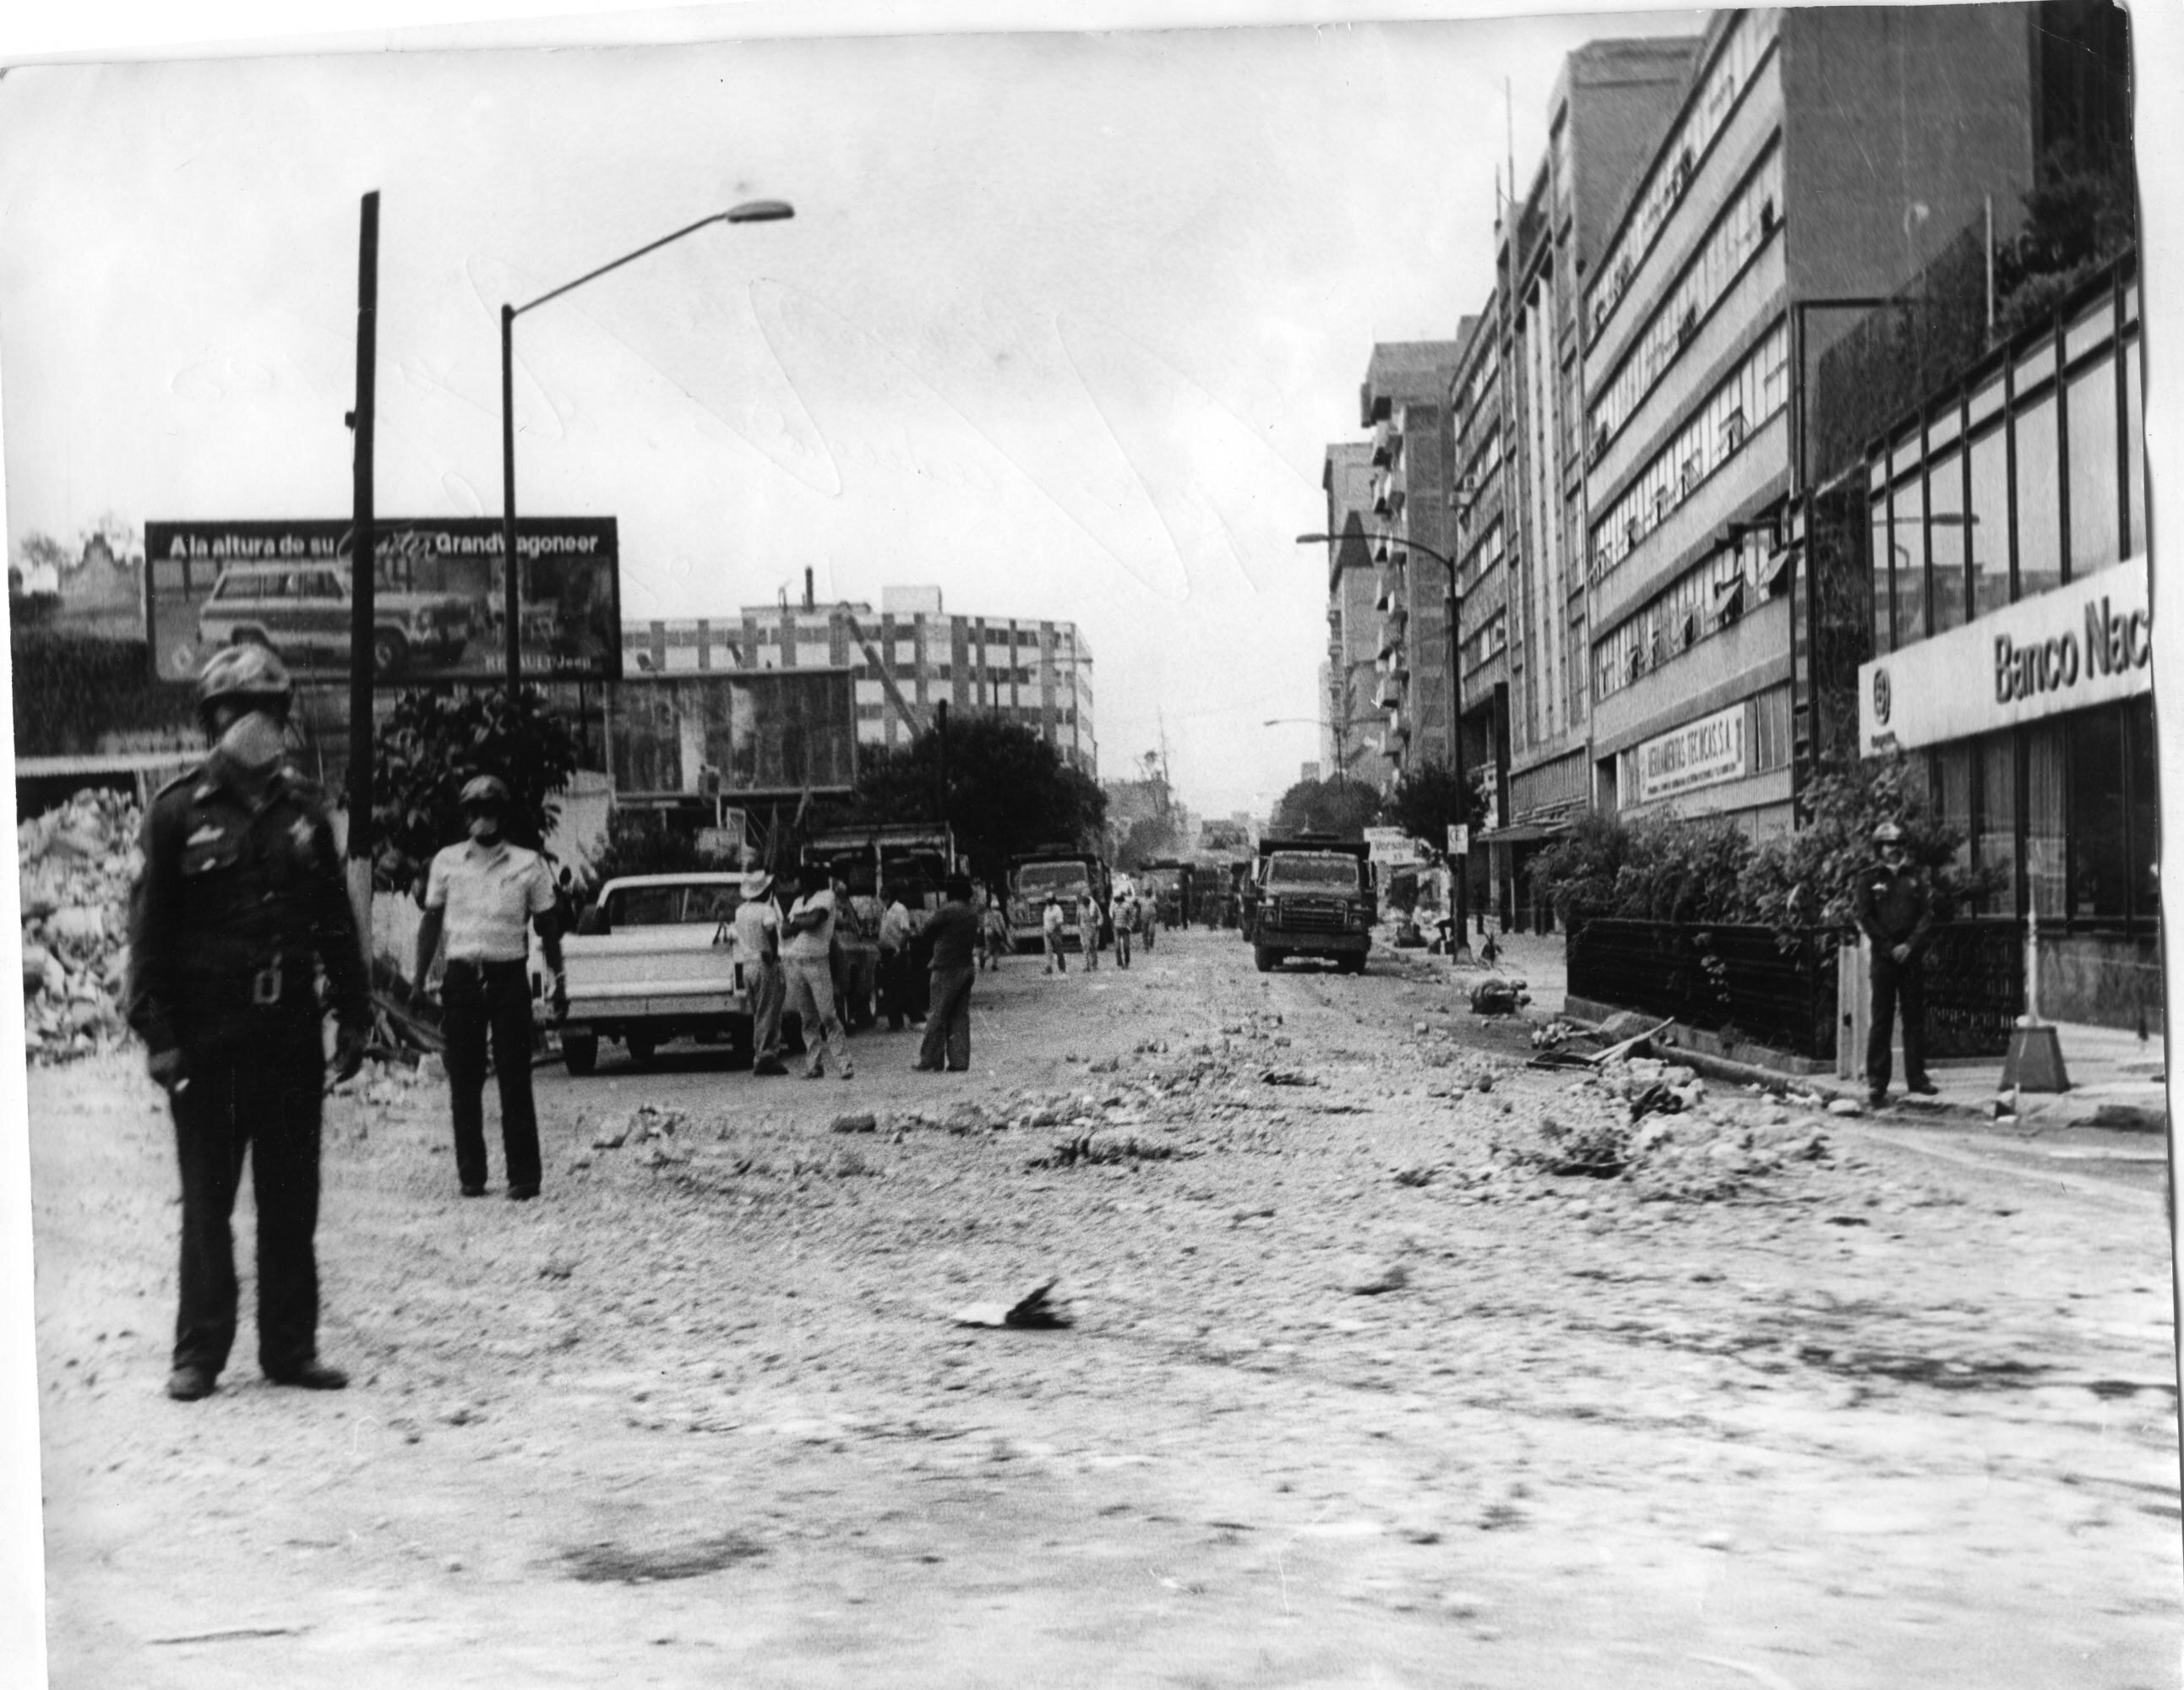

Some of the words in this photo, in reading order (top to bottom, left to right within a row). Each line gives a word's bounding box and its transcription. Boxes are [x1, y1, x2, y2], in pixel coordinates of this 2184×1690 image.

[170, 534, 187, 557] A
[189, 534, 208, 557] la
[213, 534, 275, 556] altura
[279, 533, 305, 555] de
[311, 537, 334, 555] su
[1994, 631, 2079, 704] Banco
